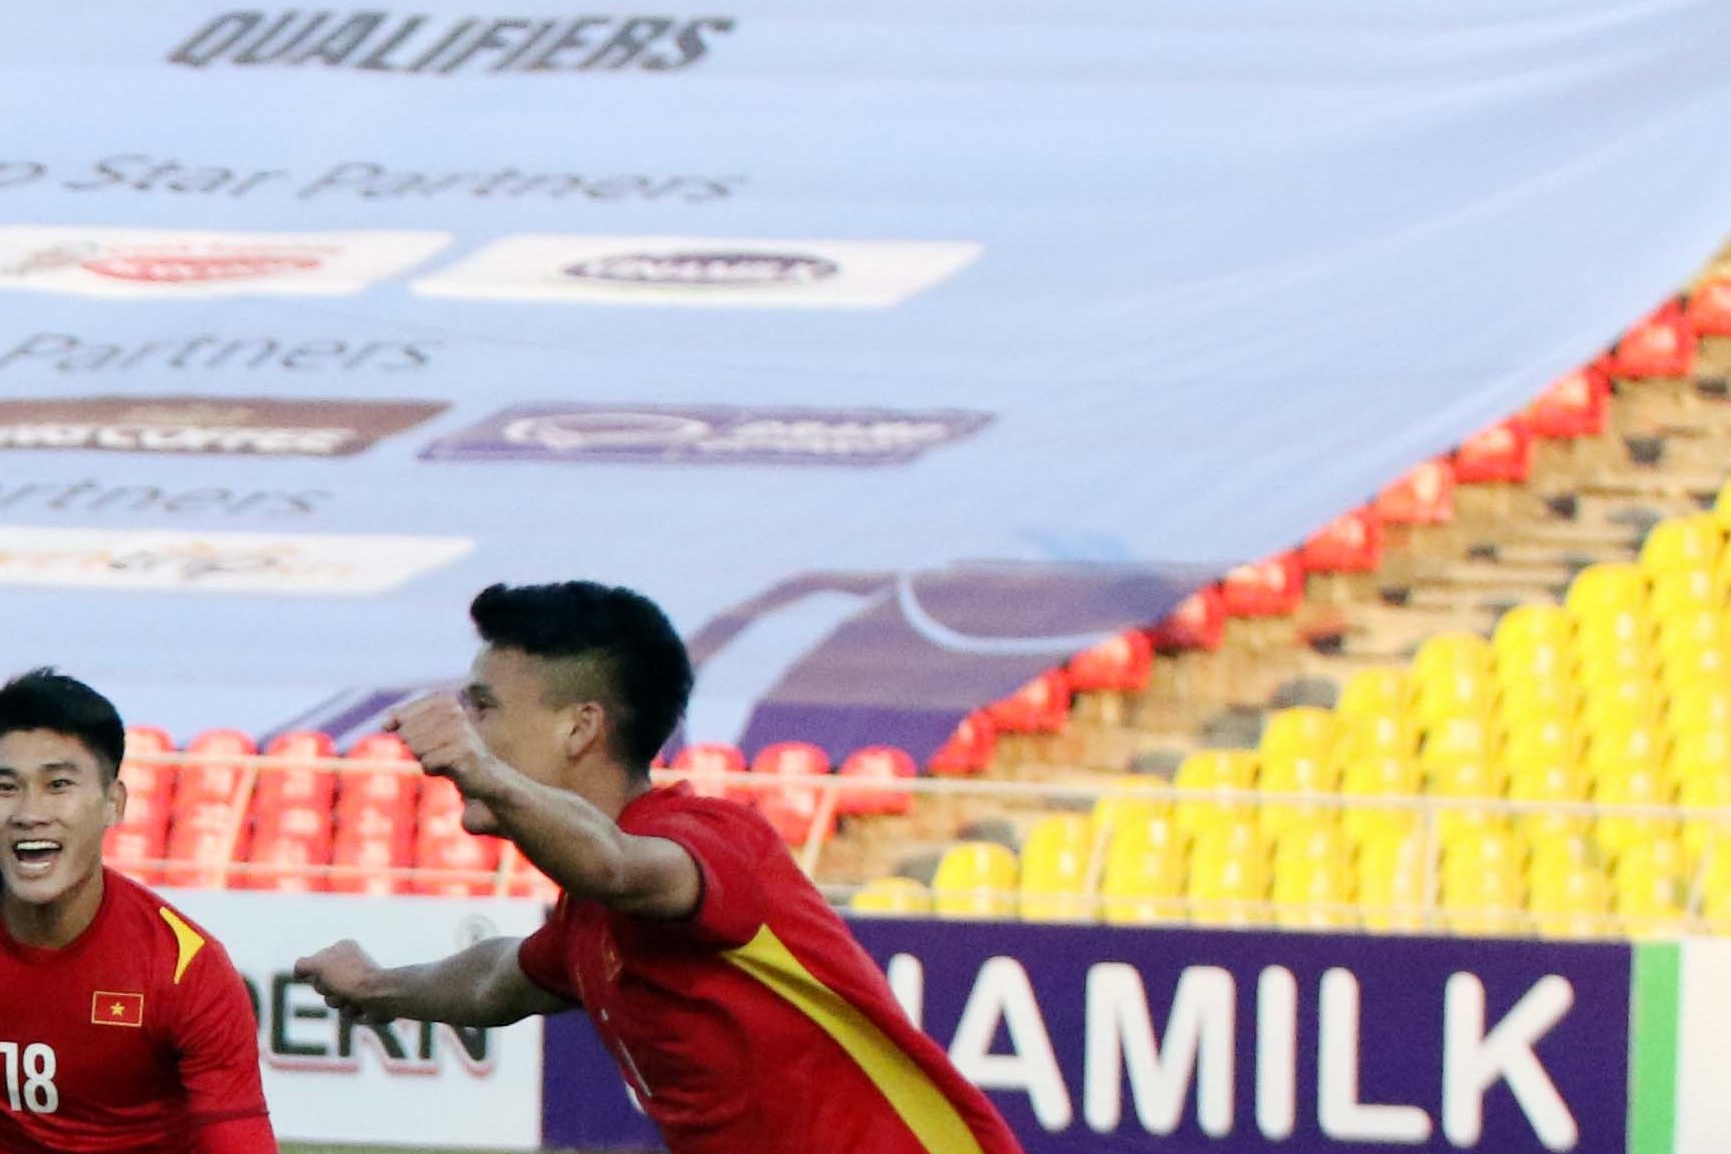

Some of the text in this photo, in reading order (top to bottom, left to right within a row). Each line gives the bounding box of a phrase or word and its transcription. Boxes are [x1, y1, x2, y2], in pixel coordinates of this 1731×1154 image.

[168, 9, 737, 75] QUALIFIERS
[62, 153, 290, 197] Star
[297, 161, 748, 201] Partners
